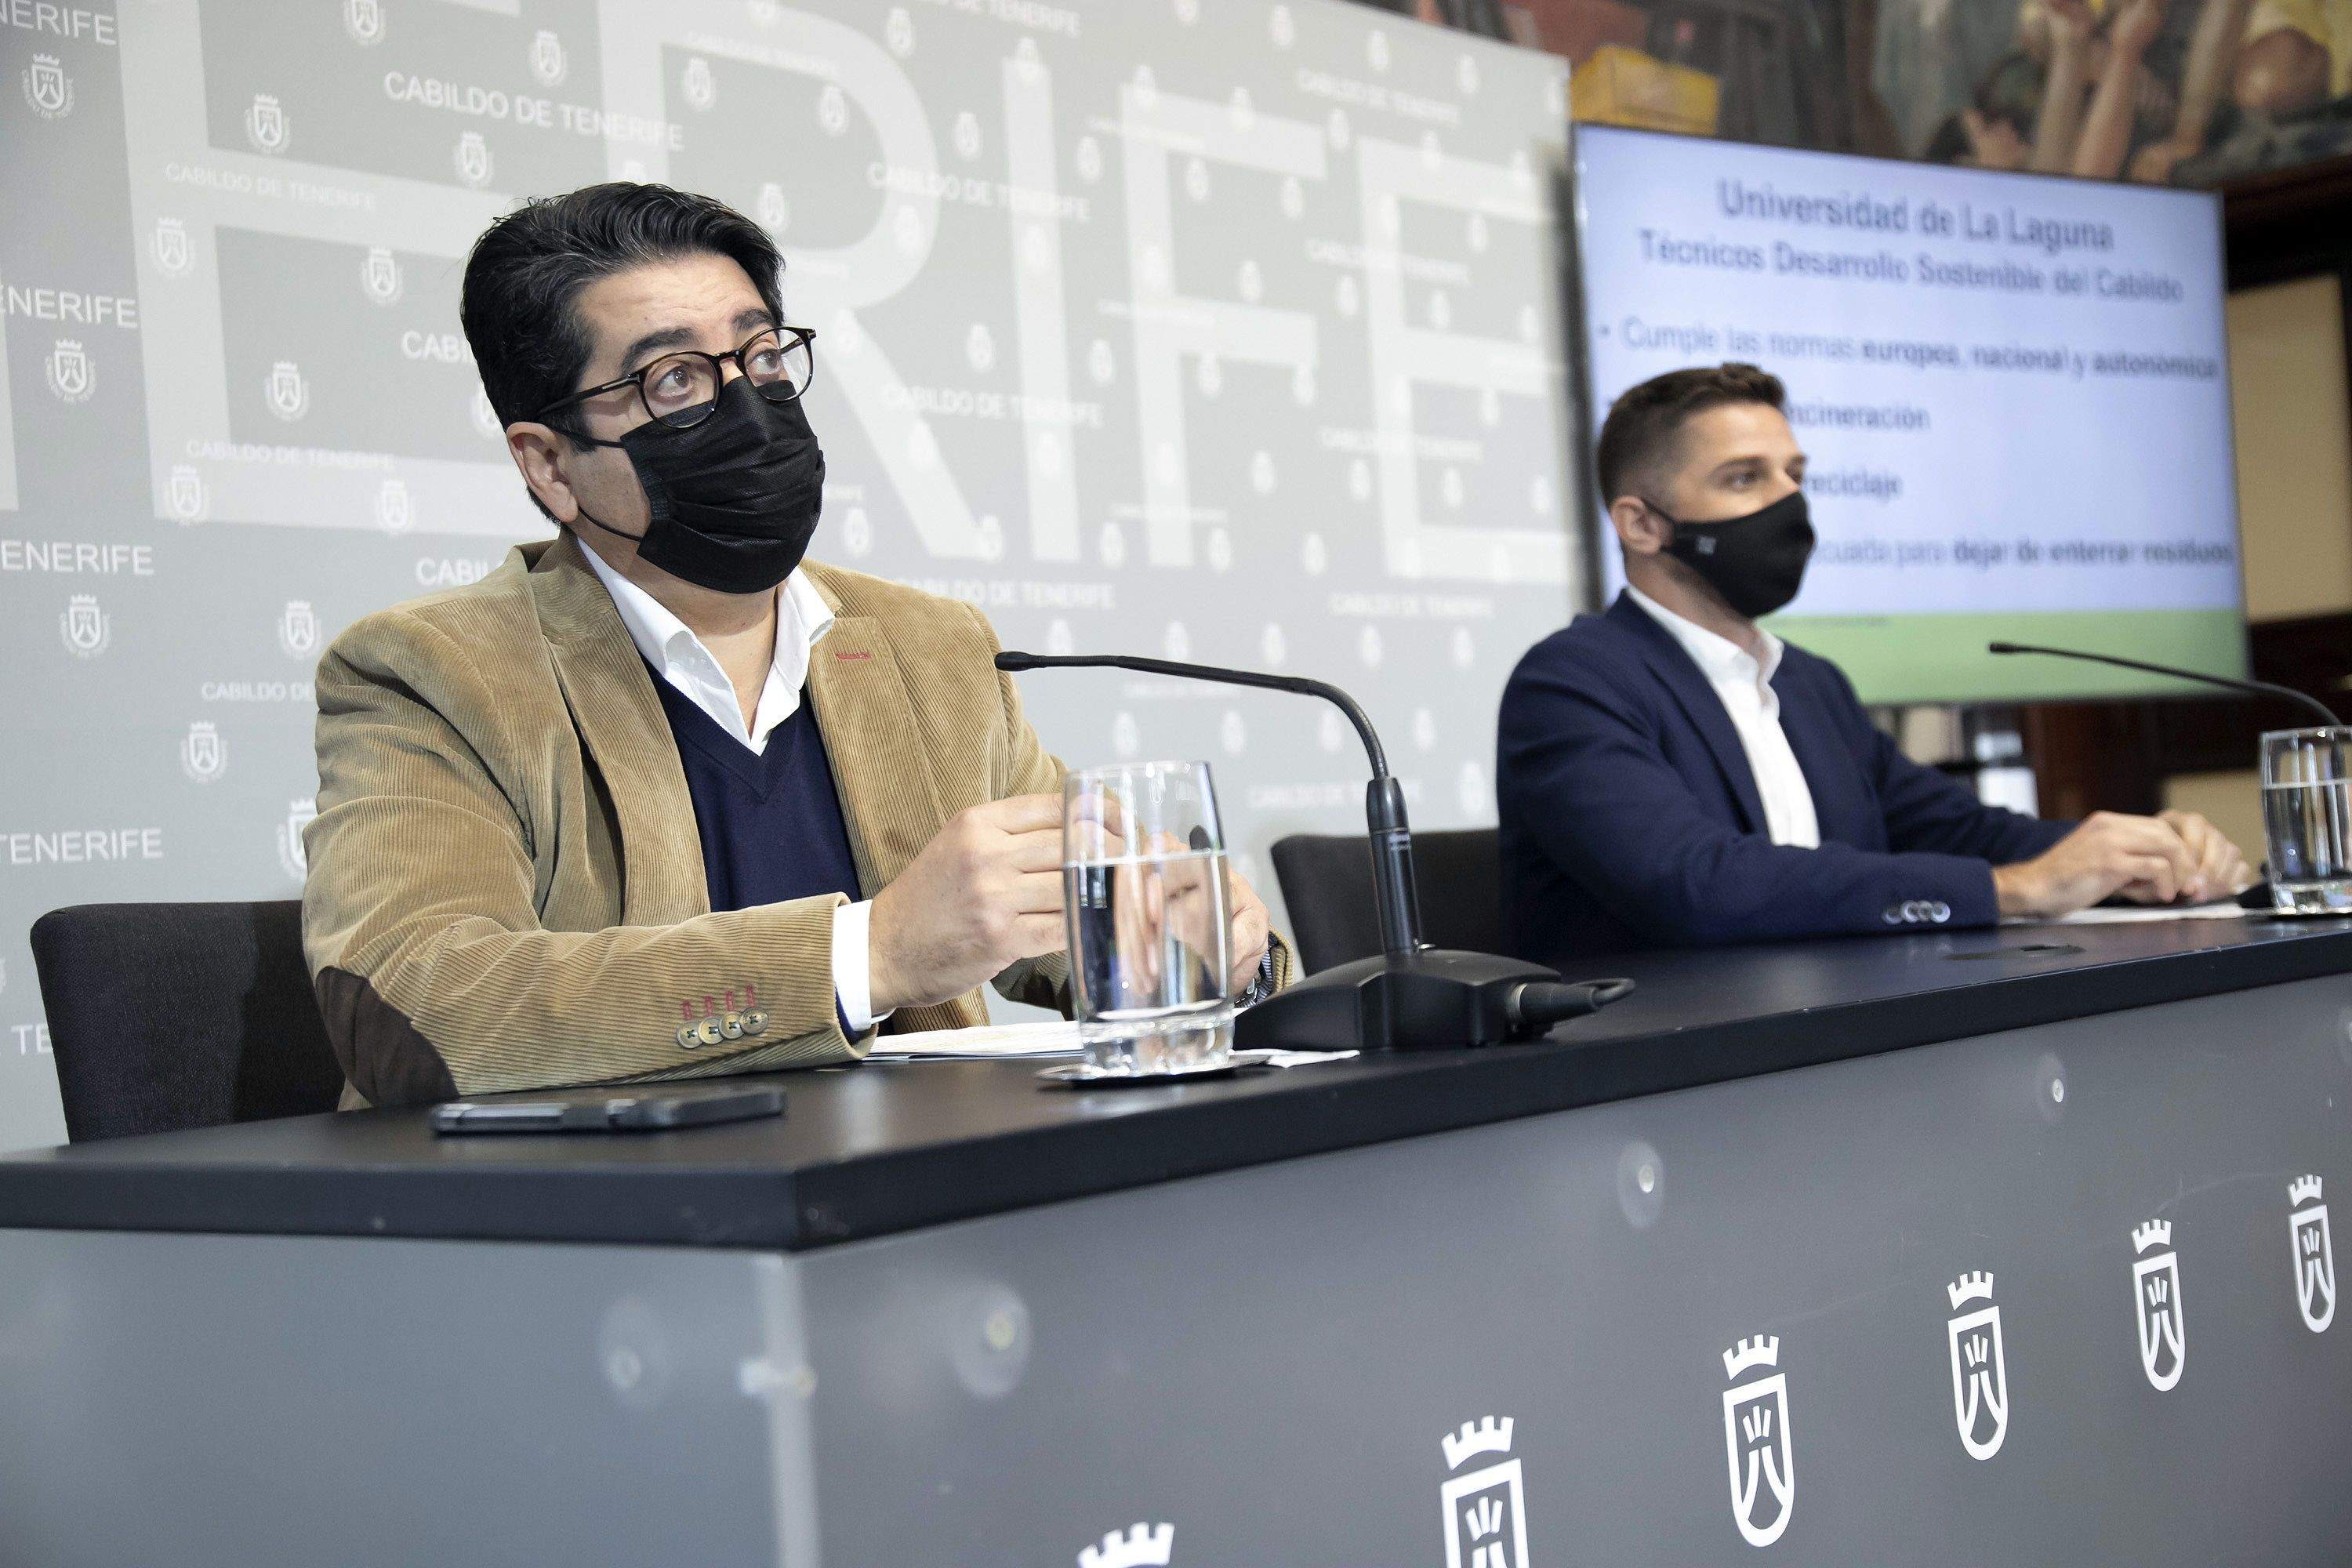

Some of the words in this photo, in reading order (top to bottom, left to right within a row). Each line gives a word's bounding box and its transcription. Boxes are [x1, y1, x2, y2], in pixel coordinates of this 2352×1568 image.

[384, 71, 510, 119] CABILDO
[515, 95, 554, 129] DE
[559, 103, 684, 151] TENERIFE
[165, 162, 252, 194] CABILDO
[256, 176, 282, 198] DE
[289, 181, 377, 211] TENERIFE
[1715, 175, 1909, 233] Universidad
[1917, 197, 1955, 238] de
[1962, 201, 1999, 241] La
[2004, 205, 2114, 257] Laguna
[1638, 226, 1765, 270] Técnicos
[1770, 239, 1909, 283] Desarrollo
[1915, 252, 2045, 295] Sostenible
[2096, 267, 2184, 303] Cabildo
[0, 284, 138, 328] NERIFE
[401, 329, 476, 365] CABI
[1785, 397, 1931, 430] ncineración
[186, 440, 271, 464] CABILDO
[277, 446, 302, 465] DE
[416, 557, 488, 586] CABI
[201, 681, 287, 702] CABILDO
